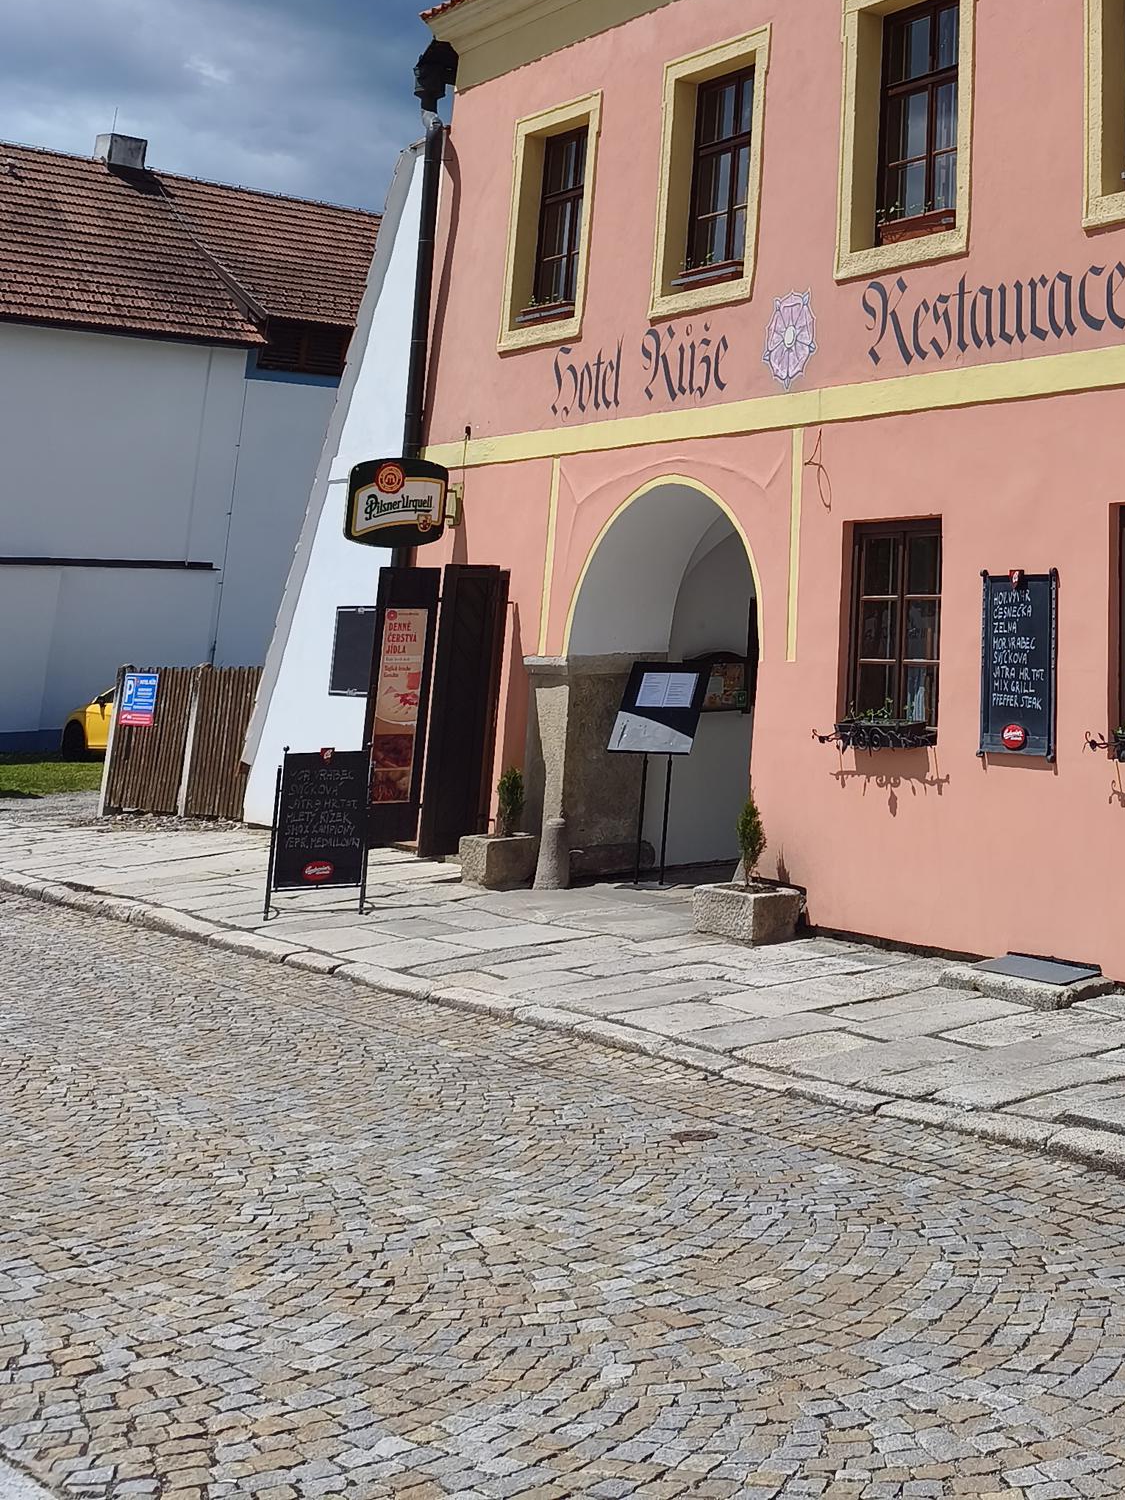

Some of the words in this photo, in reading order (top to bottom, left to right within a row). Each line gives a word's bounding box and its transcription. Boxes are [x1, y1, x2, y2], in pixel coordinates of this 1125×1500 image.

[551, 333, 624, 421] Hotel
[641, 320, 729, 402] Růže
[364, 493, 402, 521] Pilsner
[401, 493, 433, 514] Urquell
[993, 618, 1019, 634] ZELNÁ
[385, 644, 407, 654] JÍDLA
[125, 679, 134, 703] P
[993, 680, 1009, 692] MIX
[1011, 681, 1036, 694] GRILL
[992, 693, 1019, 708] PFEFFER
[1020, 696, 1042, 710] STEAK
